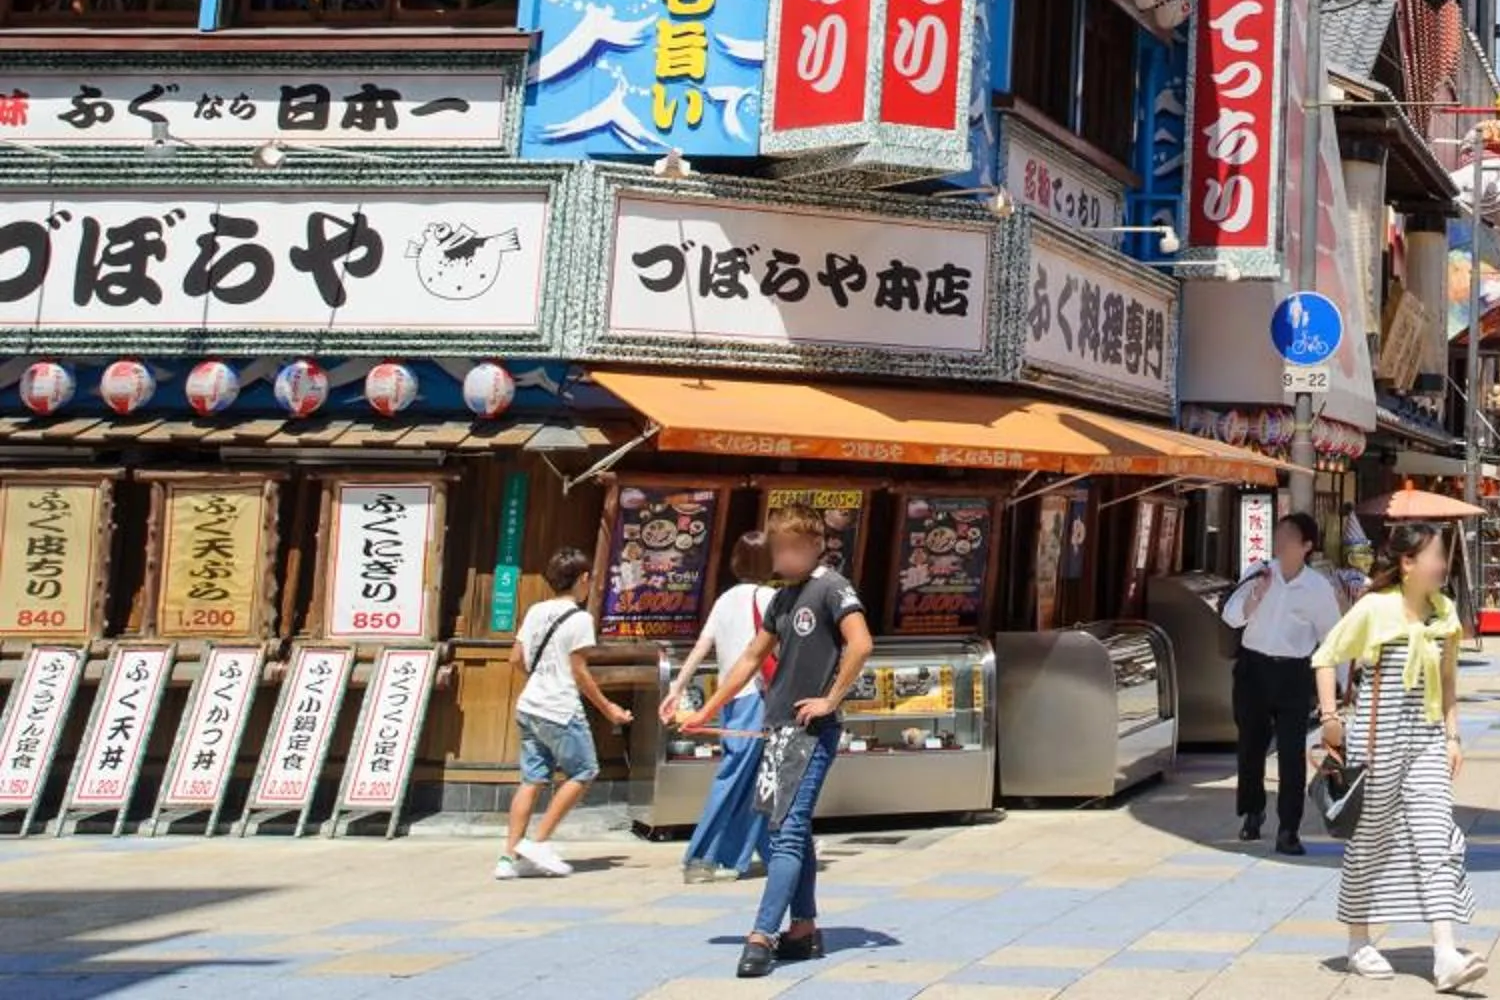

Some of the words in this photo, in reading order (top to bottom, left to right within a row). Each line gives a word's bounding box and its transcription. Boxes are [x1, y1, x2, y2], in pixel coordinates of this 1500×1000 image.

[0, 208, 382, 307] づぼらや
[630, 239, 972, 317] づぼらや本店
[1028, 262, 1164, 380] ふぐ料理専門
[26, 487, 72, 601] ふぐ皮ちり
[187, 494, 240, 601] ふぐ天ぷら
[361, 492, 406, 603] ふぐにぎり
[17, 609, 66, 627] 840
[353, 611, 402, 630] 850
[99, 659, 149, 771] ふぐ天丼
[192, 659, 242, 771] ふぐかつ丼
